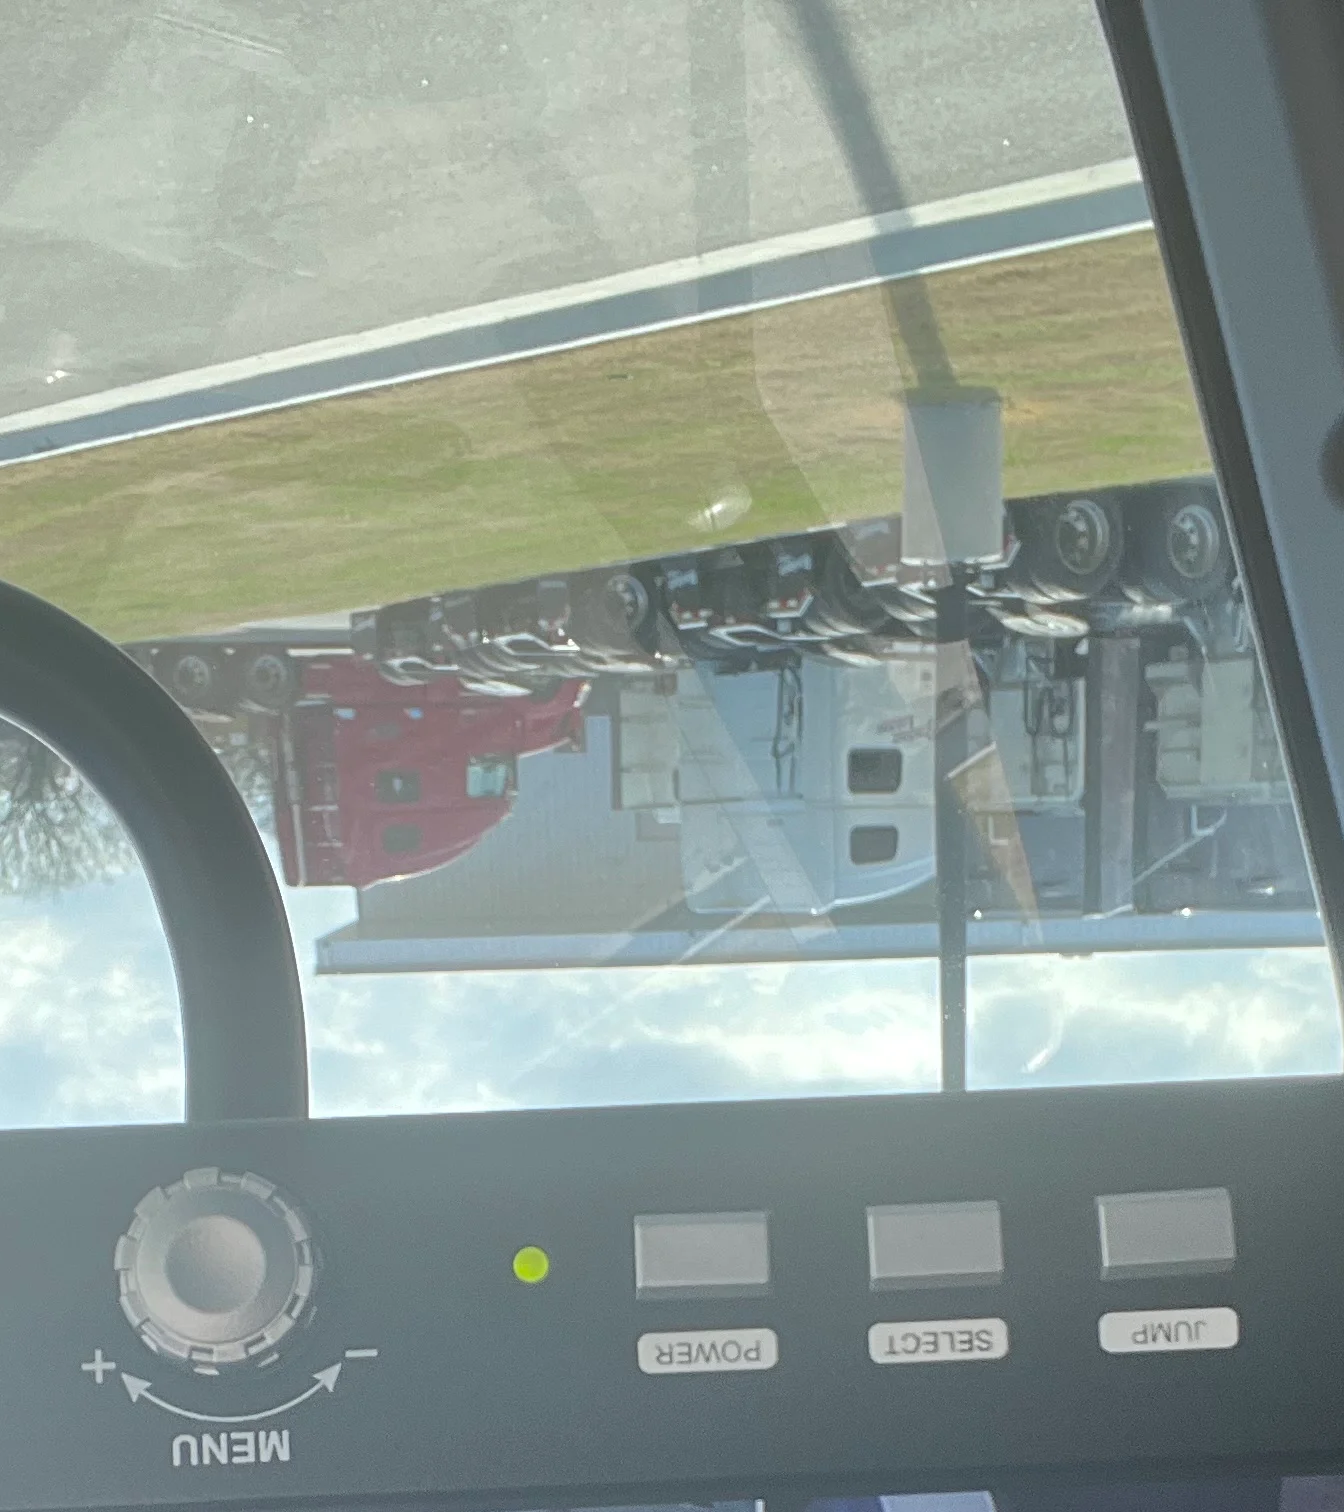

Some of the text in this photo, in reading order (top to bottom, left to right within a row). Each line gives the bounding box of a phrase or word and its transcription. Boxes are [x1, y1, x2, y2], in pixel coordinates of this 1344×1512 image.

[885, 1329, 995, 1358] SELECT
[1132, 1320, 1209, 1347] JUMP
[655, 1339, 763, 1367] POWER
[171, 1429, 292, 1468] MENU
